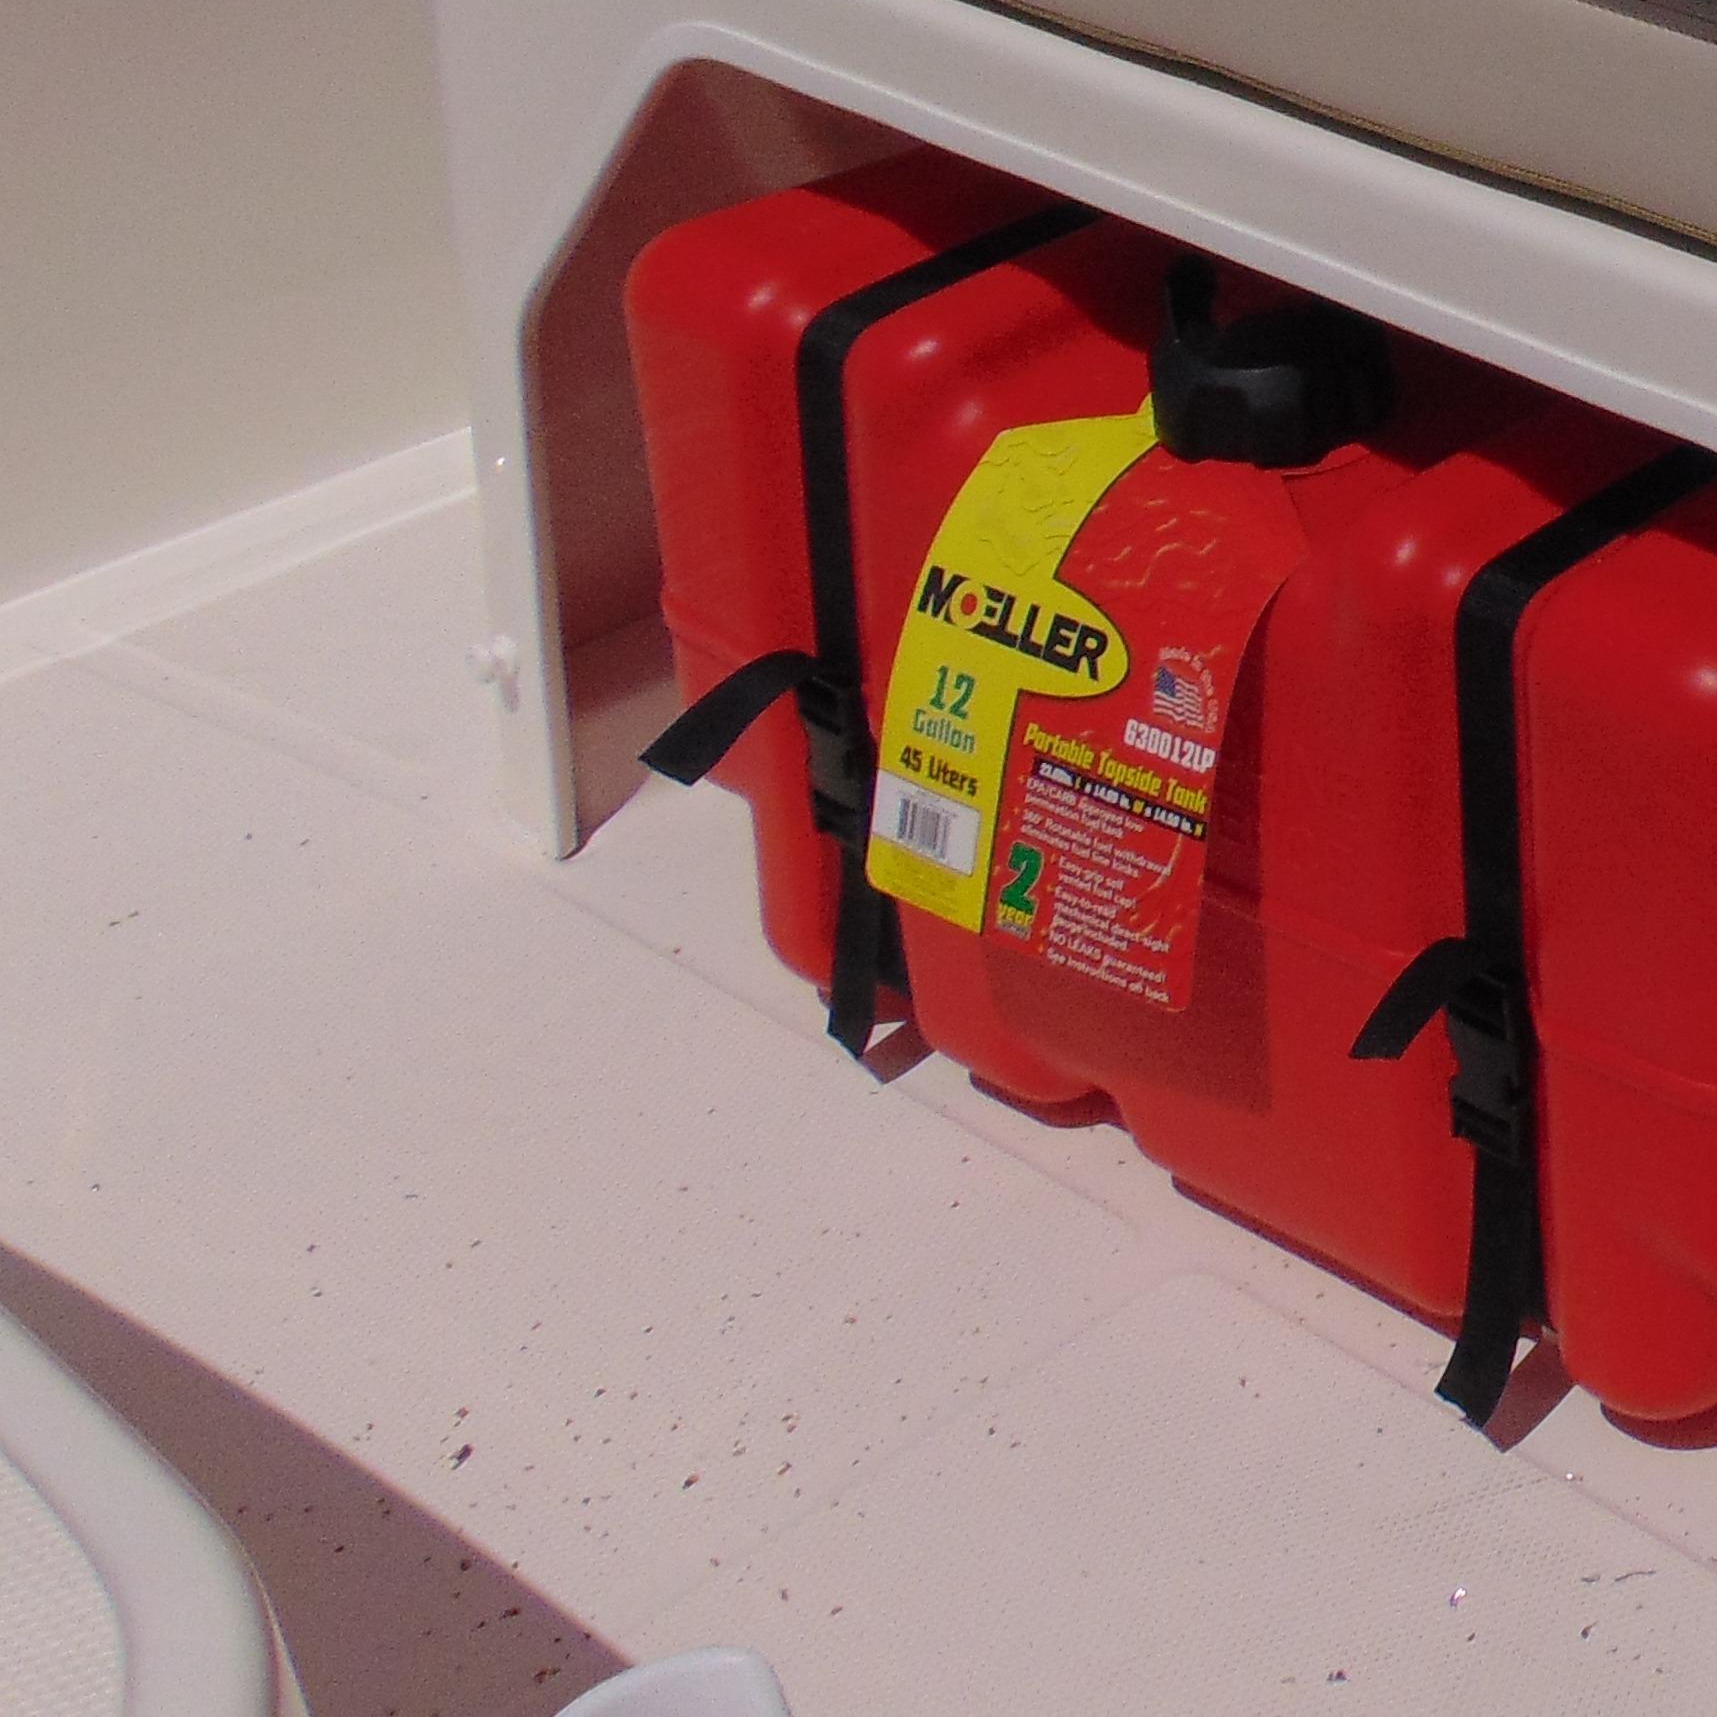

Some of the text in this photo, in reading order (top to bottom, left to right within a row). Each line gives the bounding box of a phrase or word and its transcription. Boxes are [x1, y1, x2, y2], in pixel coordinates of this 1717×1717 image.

[917, 565, 1109, 682] MOELLER
[929, 664, 976, 720] 12
[912, 708, 976, 755] Gallon
[1124, 718, 1216, 774] 630012LP
[900, 745, 979, 796] 45 Liters
[1023, 719, 1208, 816] Portable Topside Tank
[1001, 839, 1044, 914] 2
